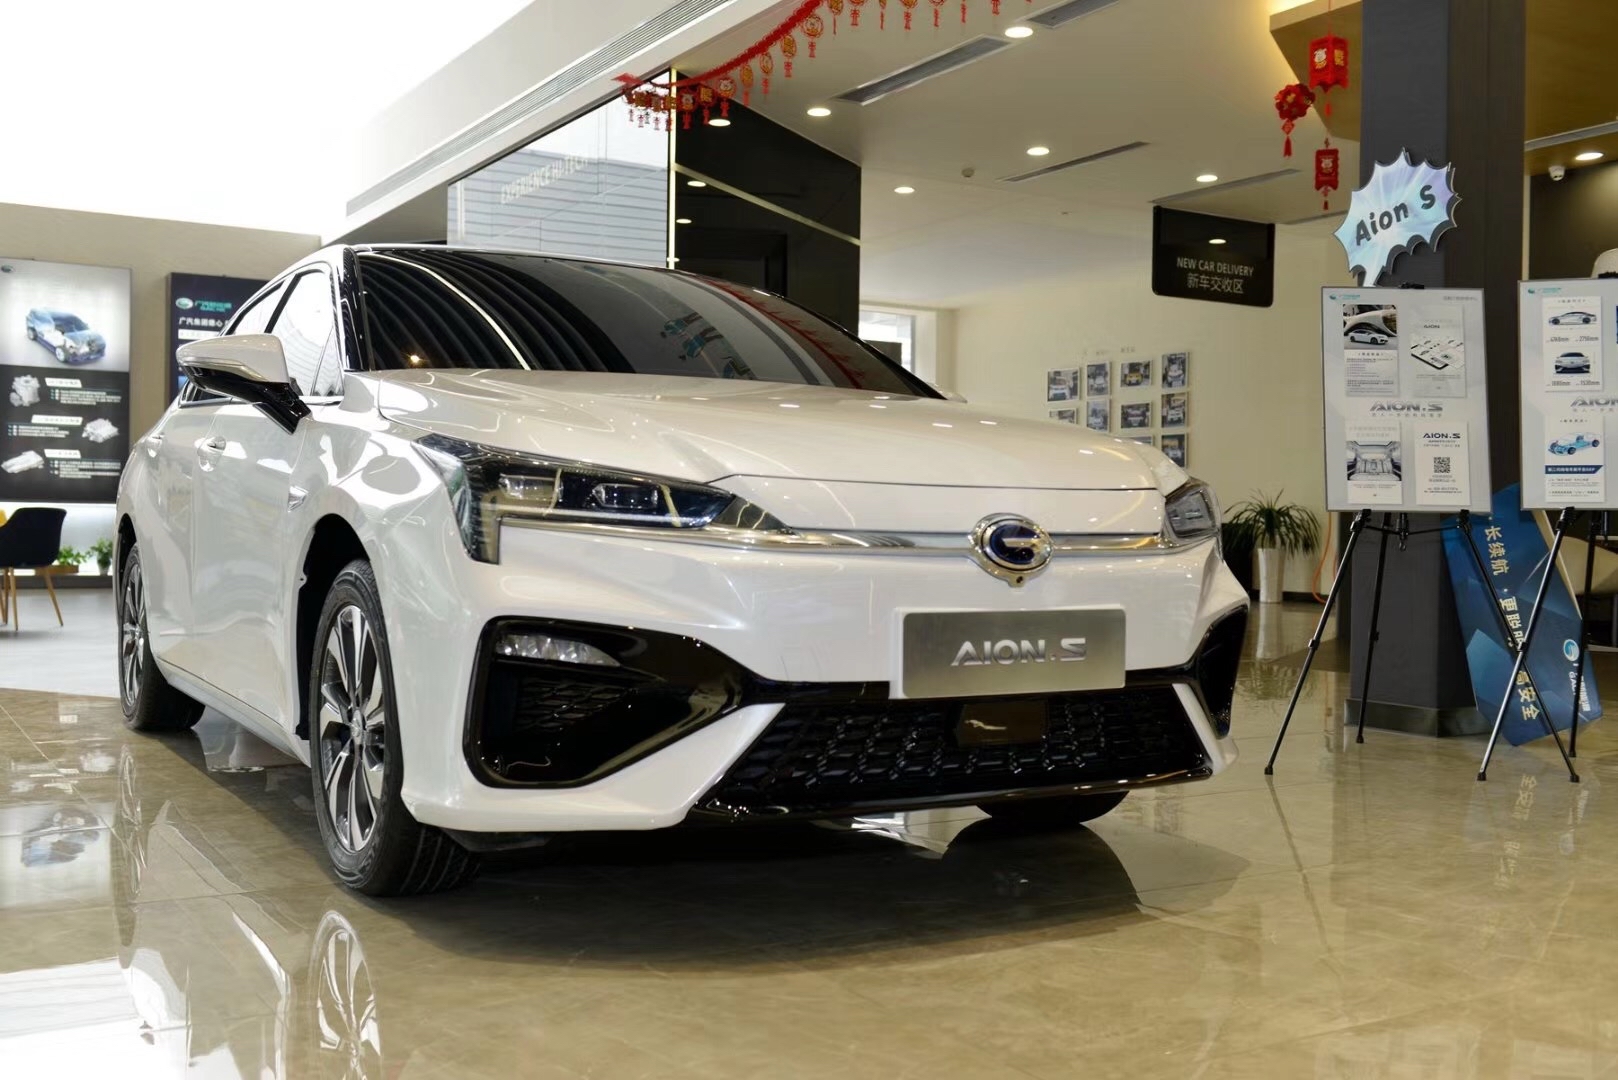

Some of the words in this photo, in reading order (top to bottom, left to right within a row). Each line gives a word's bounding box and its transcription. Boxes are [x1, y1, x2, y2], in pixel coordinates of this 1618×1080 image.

[1354, 201, 1409, 247] Aion
[1419, 184, 1437, 210] S
[1176, 257, 1196, 269] NEW
[1198, 259, 1215, 272] CAR
[1217, 262, 1254, 277] DELIVERY
[1187, 273, 1244, 294] 新车交收区
[1369, 400, 1443, 412] AION.S
[951, 637, 1086, 666] AION.S
